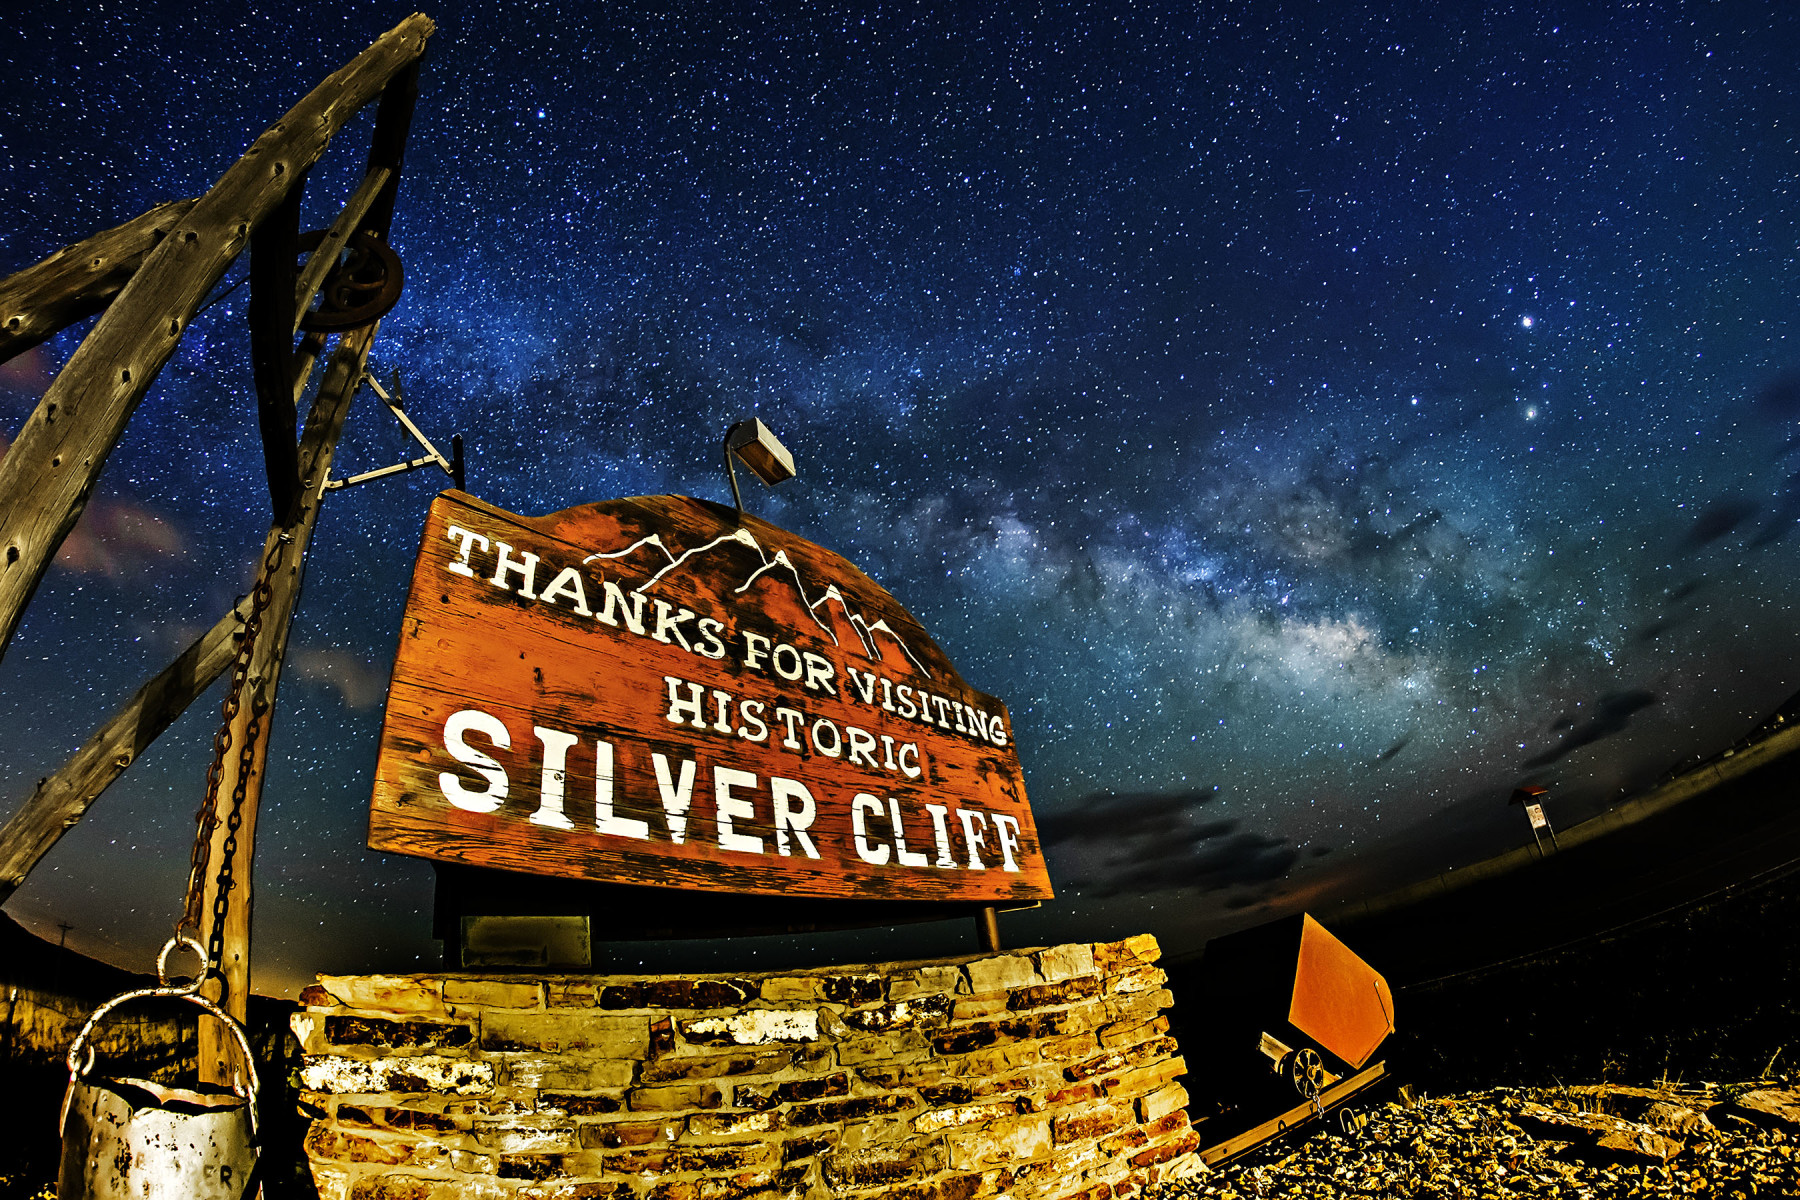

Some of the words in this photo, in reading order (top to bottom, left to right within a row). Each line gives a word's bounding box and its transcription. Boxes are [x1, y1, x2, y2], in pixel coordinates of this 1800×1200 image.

[447, 524, 726, 660] THANKS
[742, 630, 837, 695] FOR
[846, 666, 1008, 746] VISITING
[438, 709, 821, 860] SILVER
[851, 792, 1021, 873] CLIFF
[664, 675, 922, 779] HISTORIC
